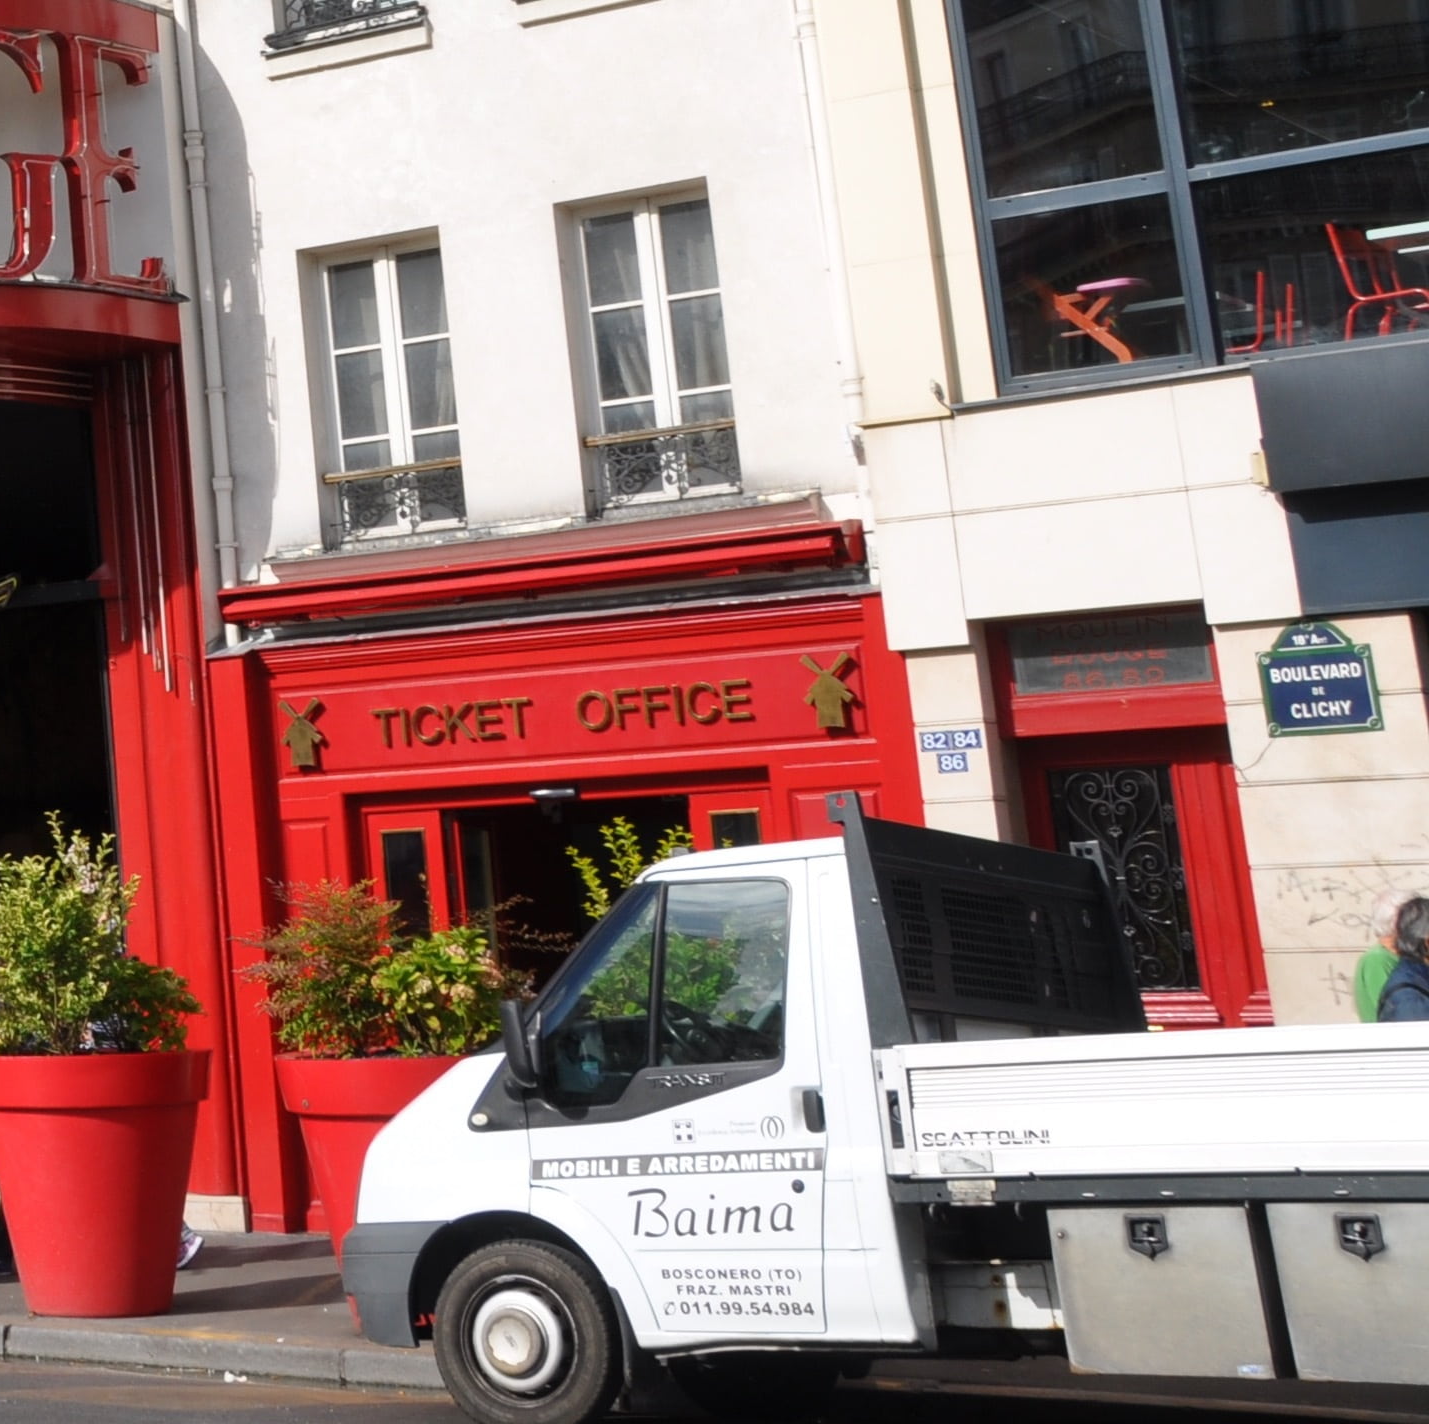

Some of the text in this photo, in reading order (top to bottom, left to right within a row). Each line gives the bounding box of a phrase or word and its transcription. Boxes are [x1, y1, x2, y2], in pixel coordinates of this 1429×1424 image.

[1036, 616, 1168, 641] MOULIN
[1269, 662, 1362, 683] BOULEVARD
[1311, 686, 1326, 696] DE
[371, 679, 755, 751] TICKET OFFICE
[1290, 700, 1352, 719] CLICHY
[922, 731, 978, 749] 82 84
[940, 754, 964, 770] 86
[646, 1072, 725, 1088] TRANSIT
[921, 1130, 1050, 1147] SCATTOLINI
[542, 1152, 814, 1178] MOBILI E ARREDAMENTI
[628, 1188, 794, 1238] Baima
[662, 1267, 802, 1282] BOSCONERO (TO)
[676, 1285, 791, 1296] FRAZ. MASTRI
[680, 1301, 814, 1316] 011.99.54.984
